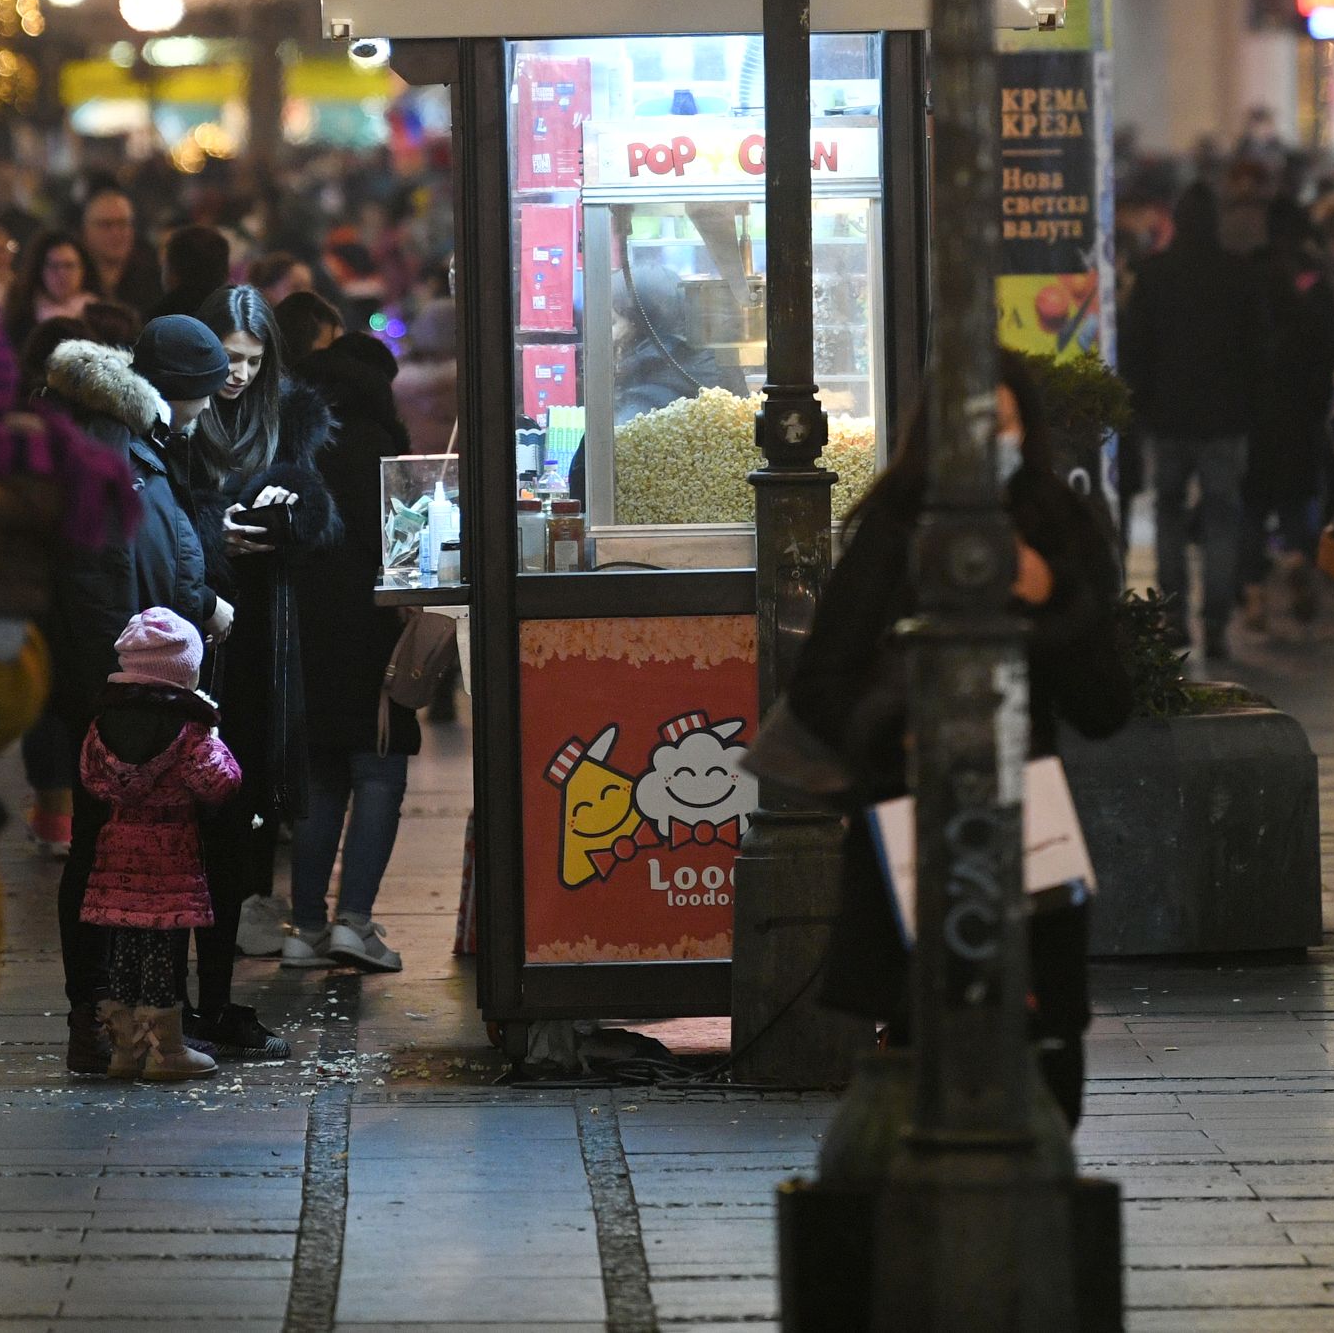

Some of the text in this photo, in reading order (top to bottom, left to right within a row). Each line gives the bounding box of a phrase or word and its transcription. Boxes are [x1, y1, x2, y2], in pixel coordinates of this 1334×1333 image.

[1002, 88, 1088, 112] КРЕМА
[1001, 113, 1084, 138] КРЕЗА
[627, 134, 838, 177] POP CN
[1003, 167, 1064, 191] Нова
[648, 859, 734, 890] Loo
